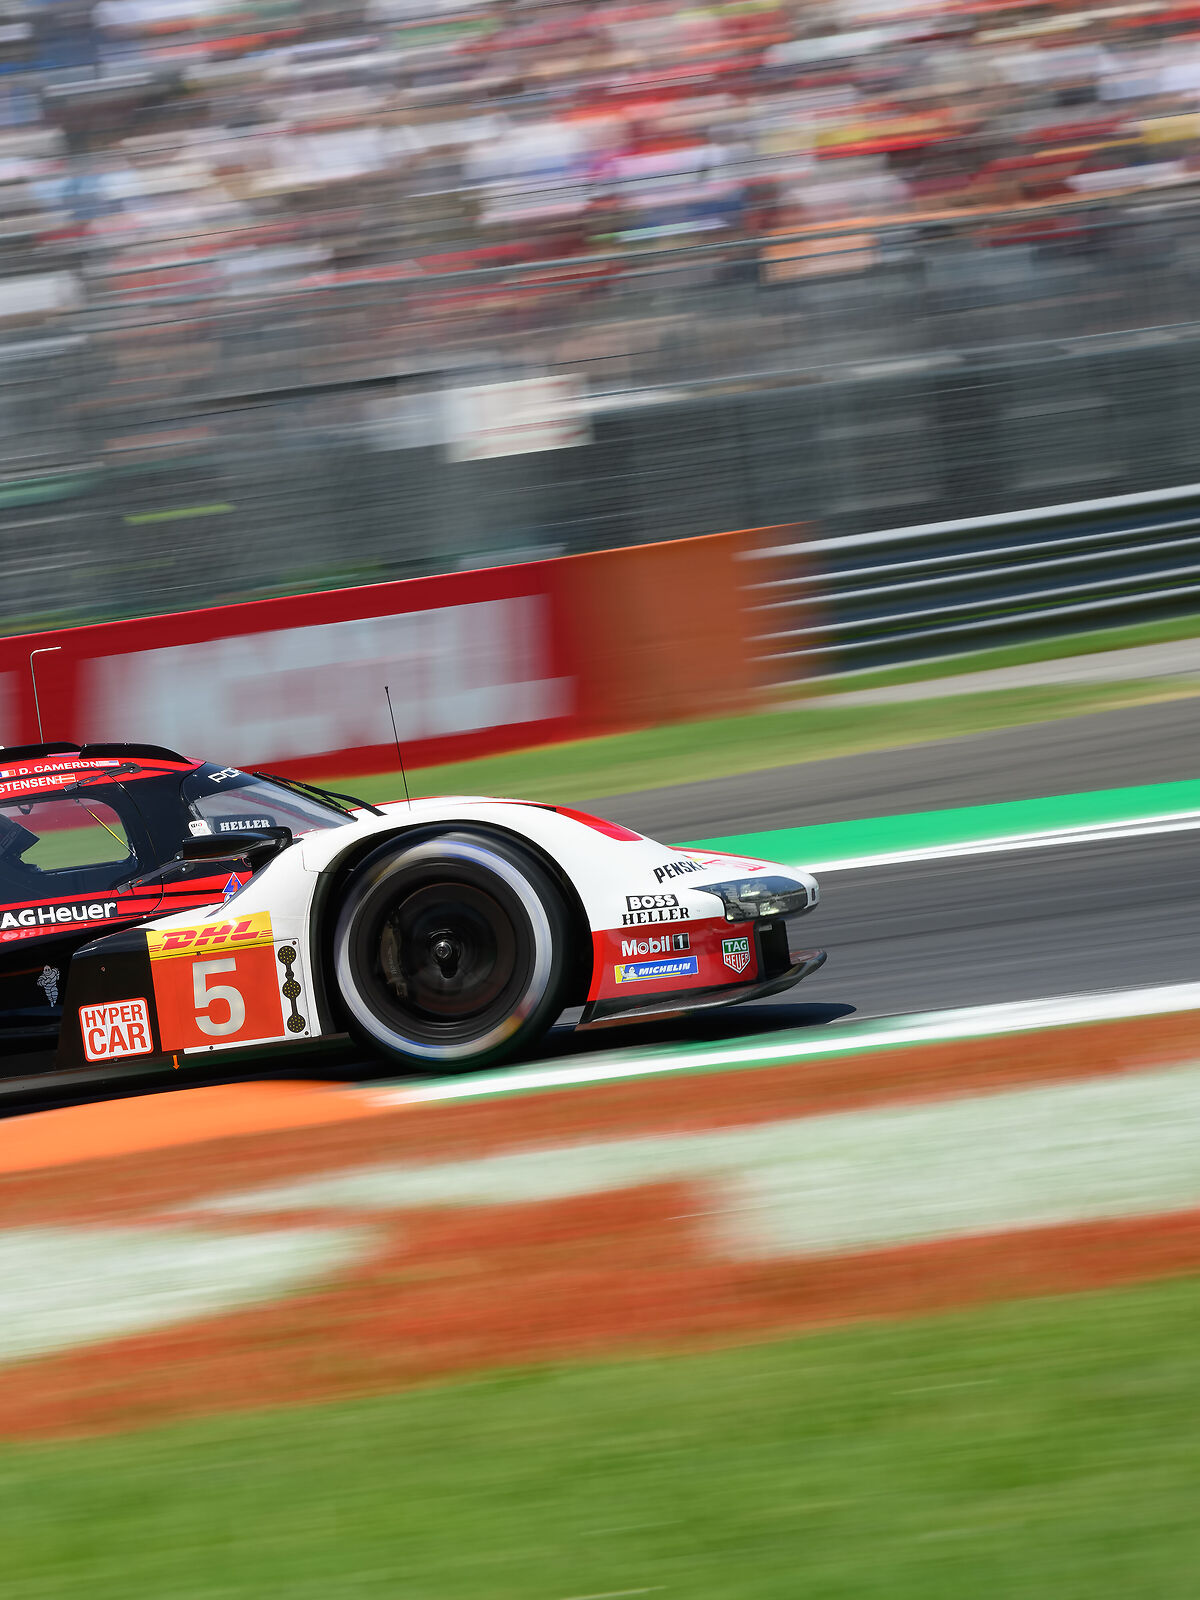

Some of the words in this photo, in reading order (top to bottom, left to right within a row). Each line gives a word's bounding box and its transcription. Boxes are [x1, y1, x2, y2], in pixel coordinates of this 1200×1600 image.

[34, 761, 99, 773] CAMERON
[219, 819, 271, 832] HELLER
[630, 894, 675, 910] BOSS
[622, 907, 690, 926] HELLER
[162, 920, 259, 951] DHL
[725, 940, 748, 952] TAG
[639, 962, 691, 976] MICHELIN
[725, 953, 749, 970] HEUER
[192, 957, 246, 1037] 5
[84, 1003, 144, 1028] HYPER
[87, 1022, 148, 1056] CAR
